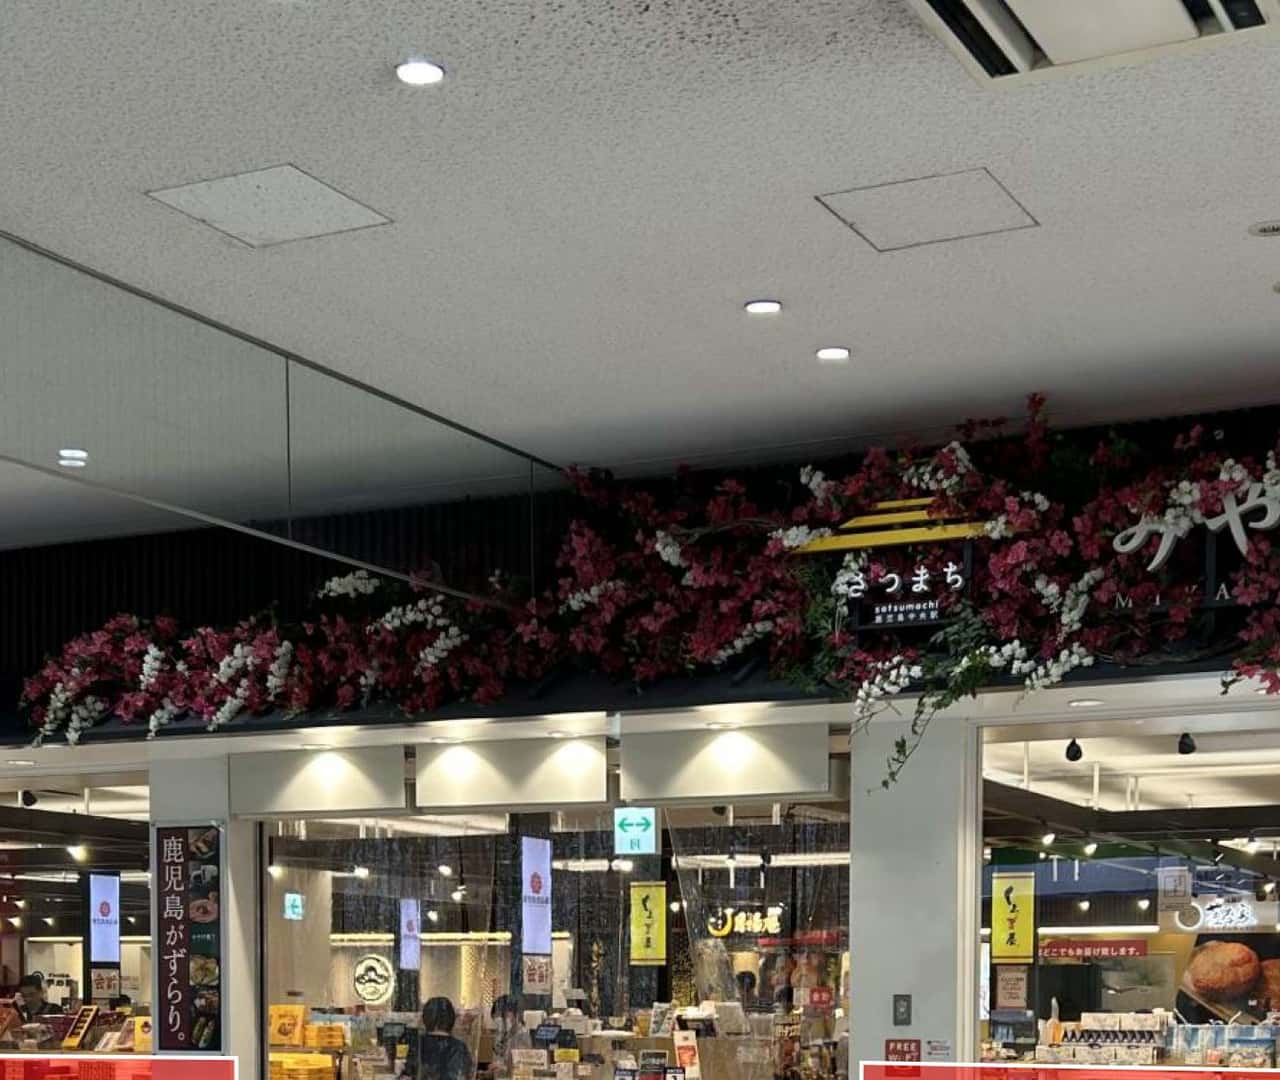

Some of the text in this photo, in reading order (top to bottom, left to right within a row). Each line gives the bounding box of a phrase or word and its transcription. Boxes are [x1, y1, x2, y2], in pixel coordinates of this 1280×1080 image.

[848, 561, 964, 598] さつまち
[875, 600, 939, 614] satsumachi
[163, 836, 186, 1041] 鹿児島がずらり。
[889, 1042, 917, 1051] FREE
